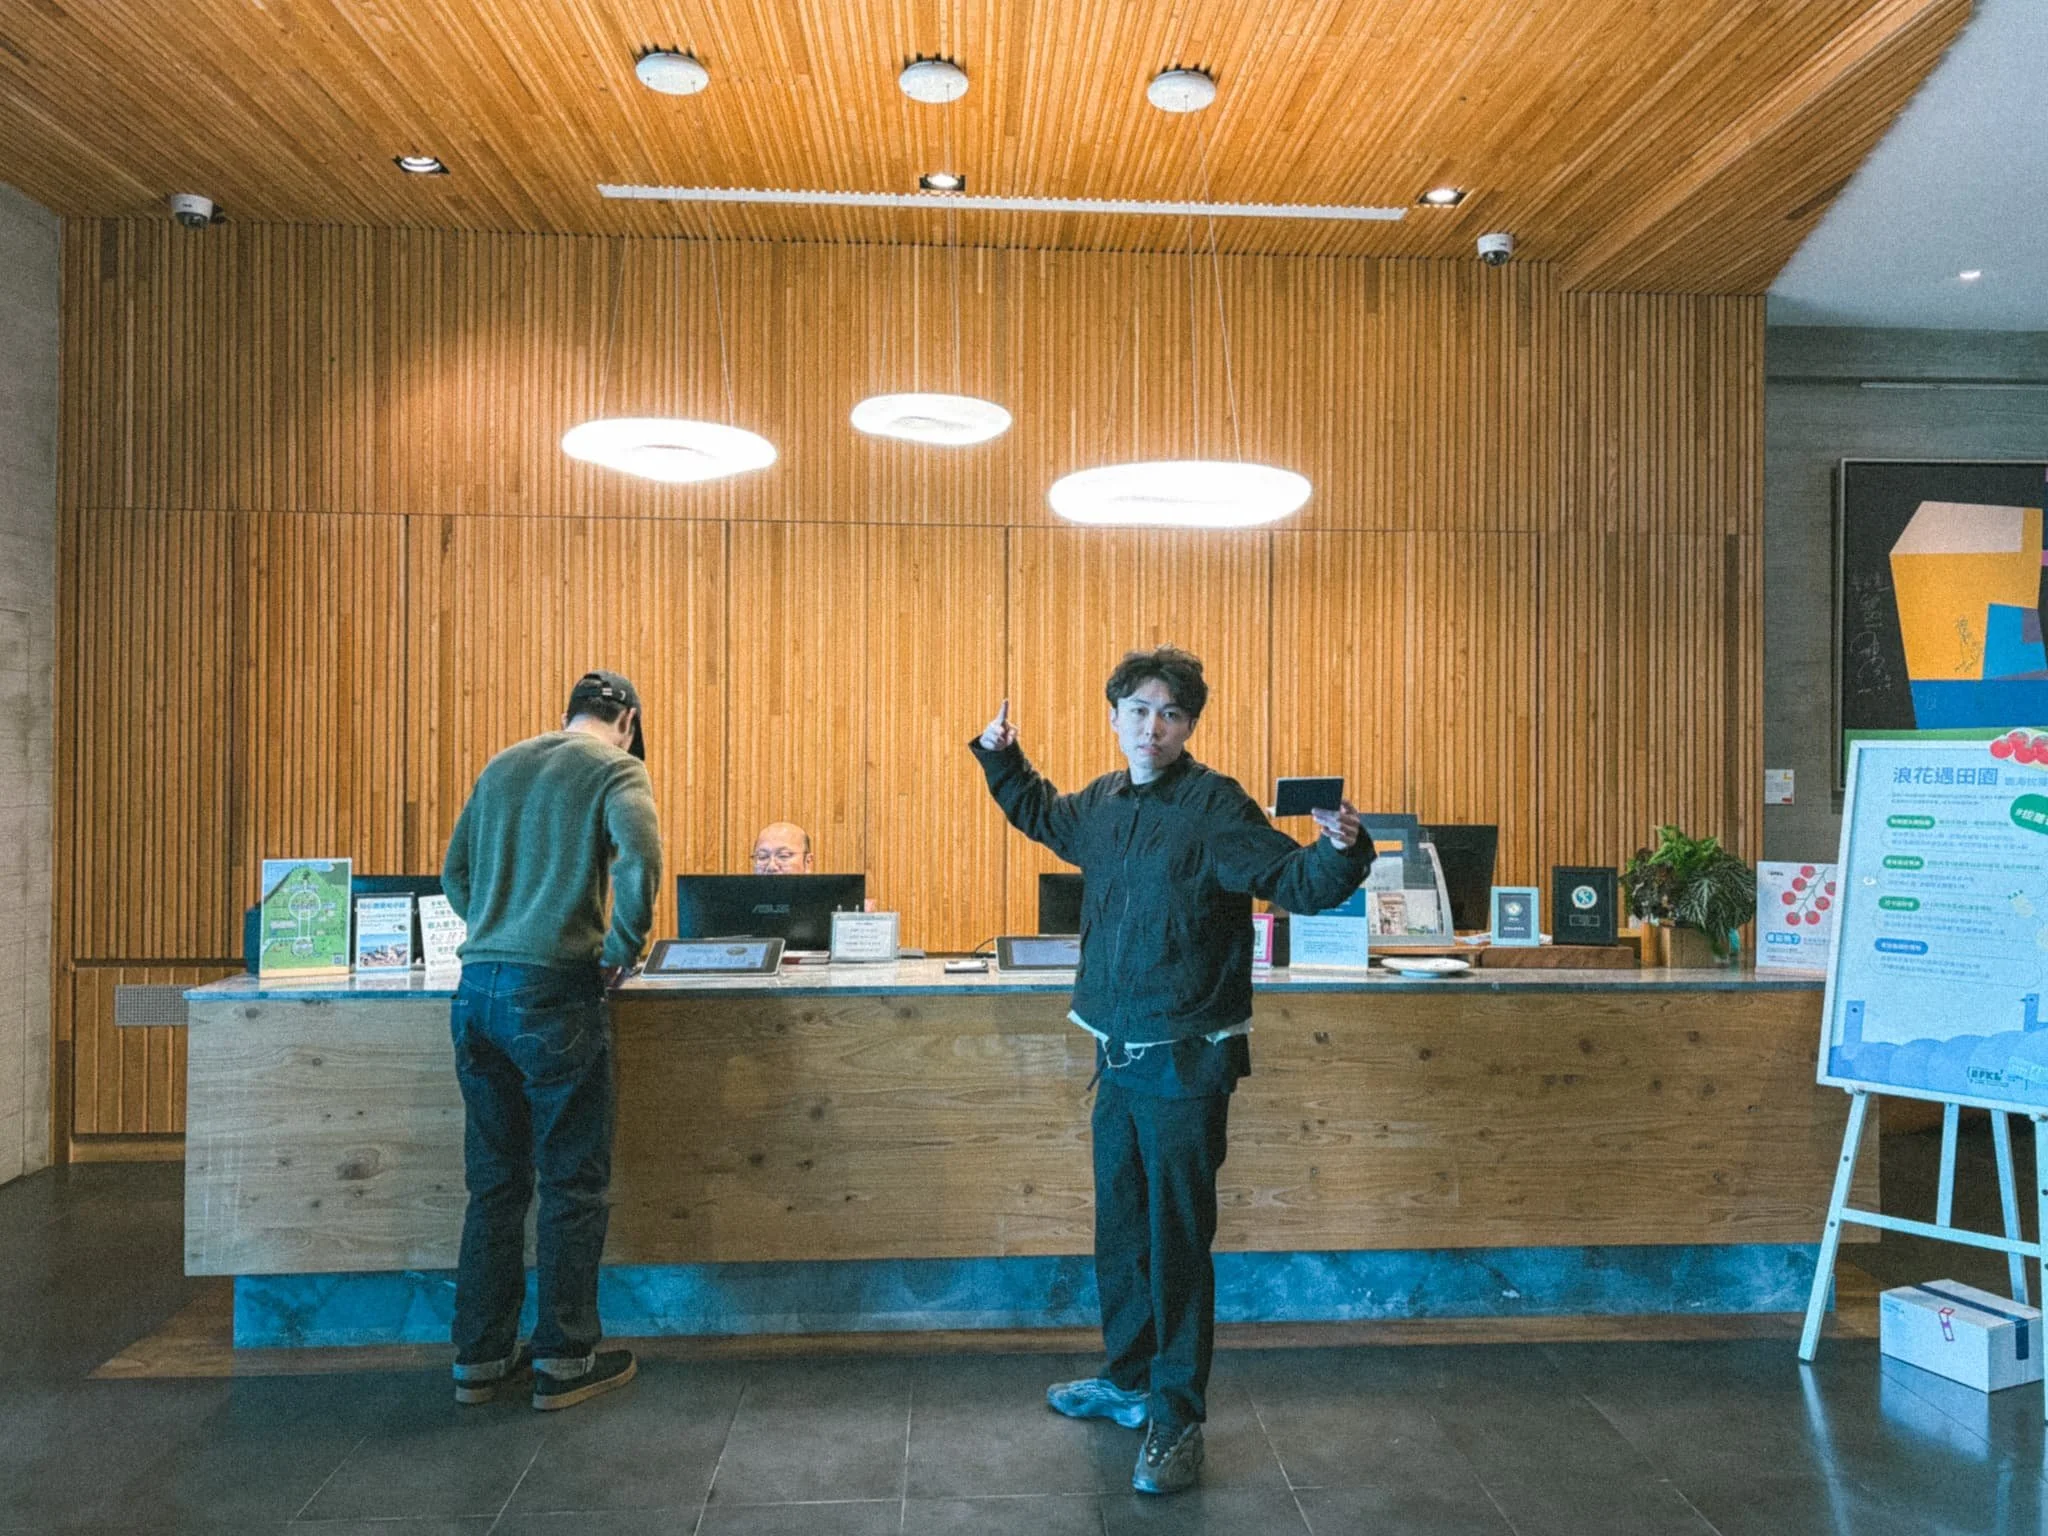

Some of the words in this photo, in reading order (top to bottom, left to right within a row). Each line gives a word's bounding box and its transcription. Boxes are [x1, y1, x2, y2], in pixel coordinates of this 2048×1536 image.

[1893, 767, 1999, 786] 浪花遇田園
[751, 903, 791, 914] ASUS
